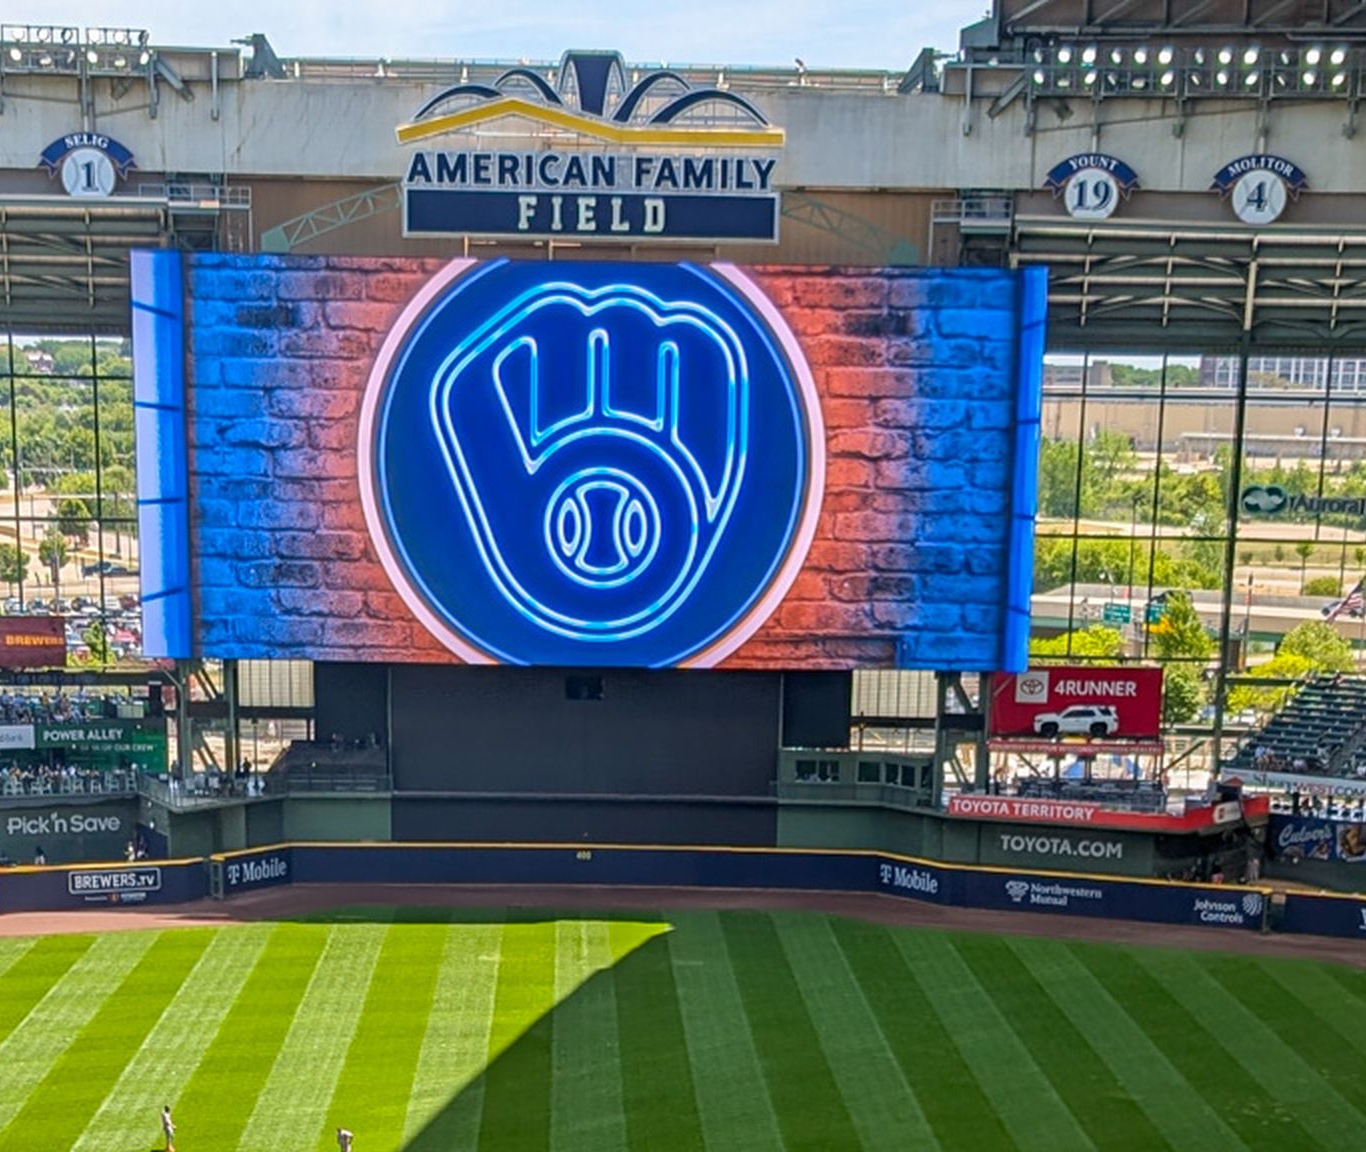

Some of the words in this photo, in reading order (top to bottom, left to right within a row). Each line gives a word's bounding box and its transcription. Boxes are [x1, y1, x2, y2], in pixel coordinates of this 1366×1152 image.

[64, 133, 109, 149] SELIG
[407, 152, 616, 187] AMERICAN
[634, 156, 776, 190] FAMILY
[1069, 154, 1119, 172] YOUNT
[1227, 155, 1295, 178] MOLITOR
[81, 160, 100, 192] 1
[1071, 178, 1110, 212] 19
[1246, 180, 1269, 213] 4
[518, 196, 666, 233] FIELD
[1054, 680, 1137, 697] 4RUNNER
[43, 728, 85, 741] POWER
[88, 728, 123, 741] ALLEY
[953, 799, 1009, 815] TOYOTA
[1013, 802, 1095, 821] TERRITORY
[71, 813, 121, 833] Save
[1000, 834, 1123, 859] TOYOTA.COM
[73, 872, 155, 890] BREWERS.TV
[241, 859, 287, 883] Mobile
[893, 867, 939, 893] Mobile
[1029, 883, 1103, 899] Northwestern
[1029, 894, 1068, 907] Mutual
[1194, 898, 1237, 913] Johnson
[1200, 910, 1244, 925] Controls
